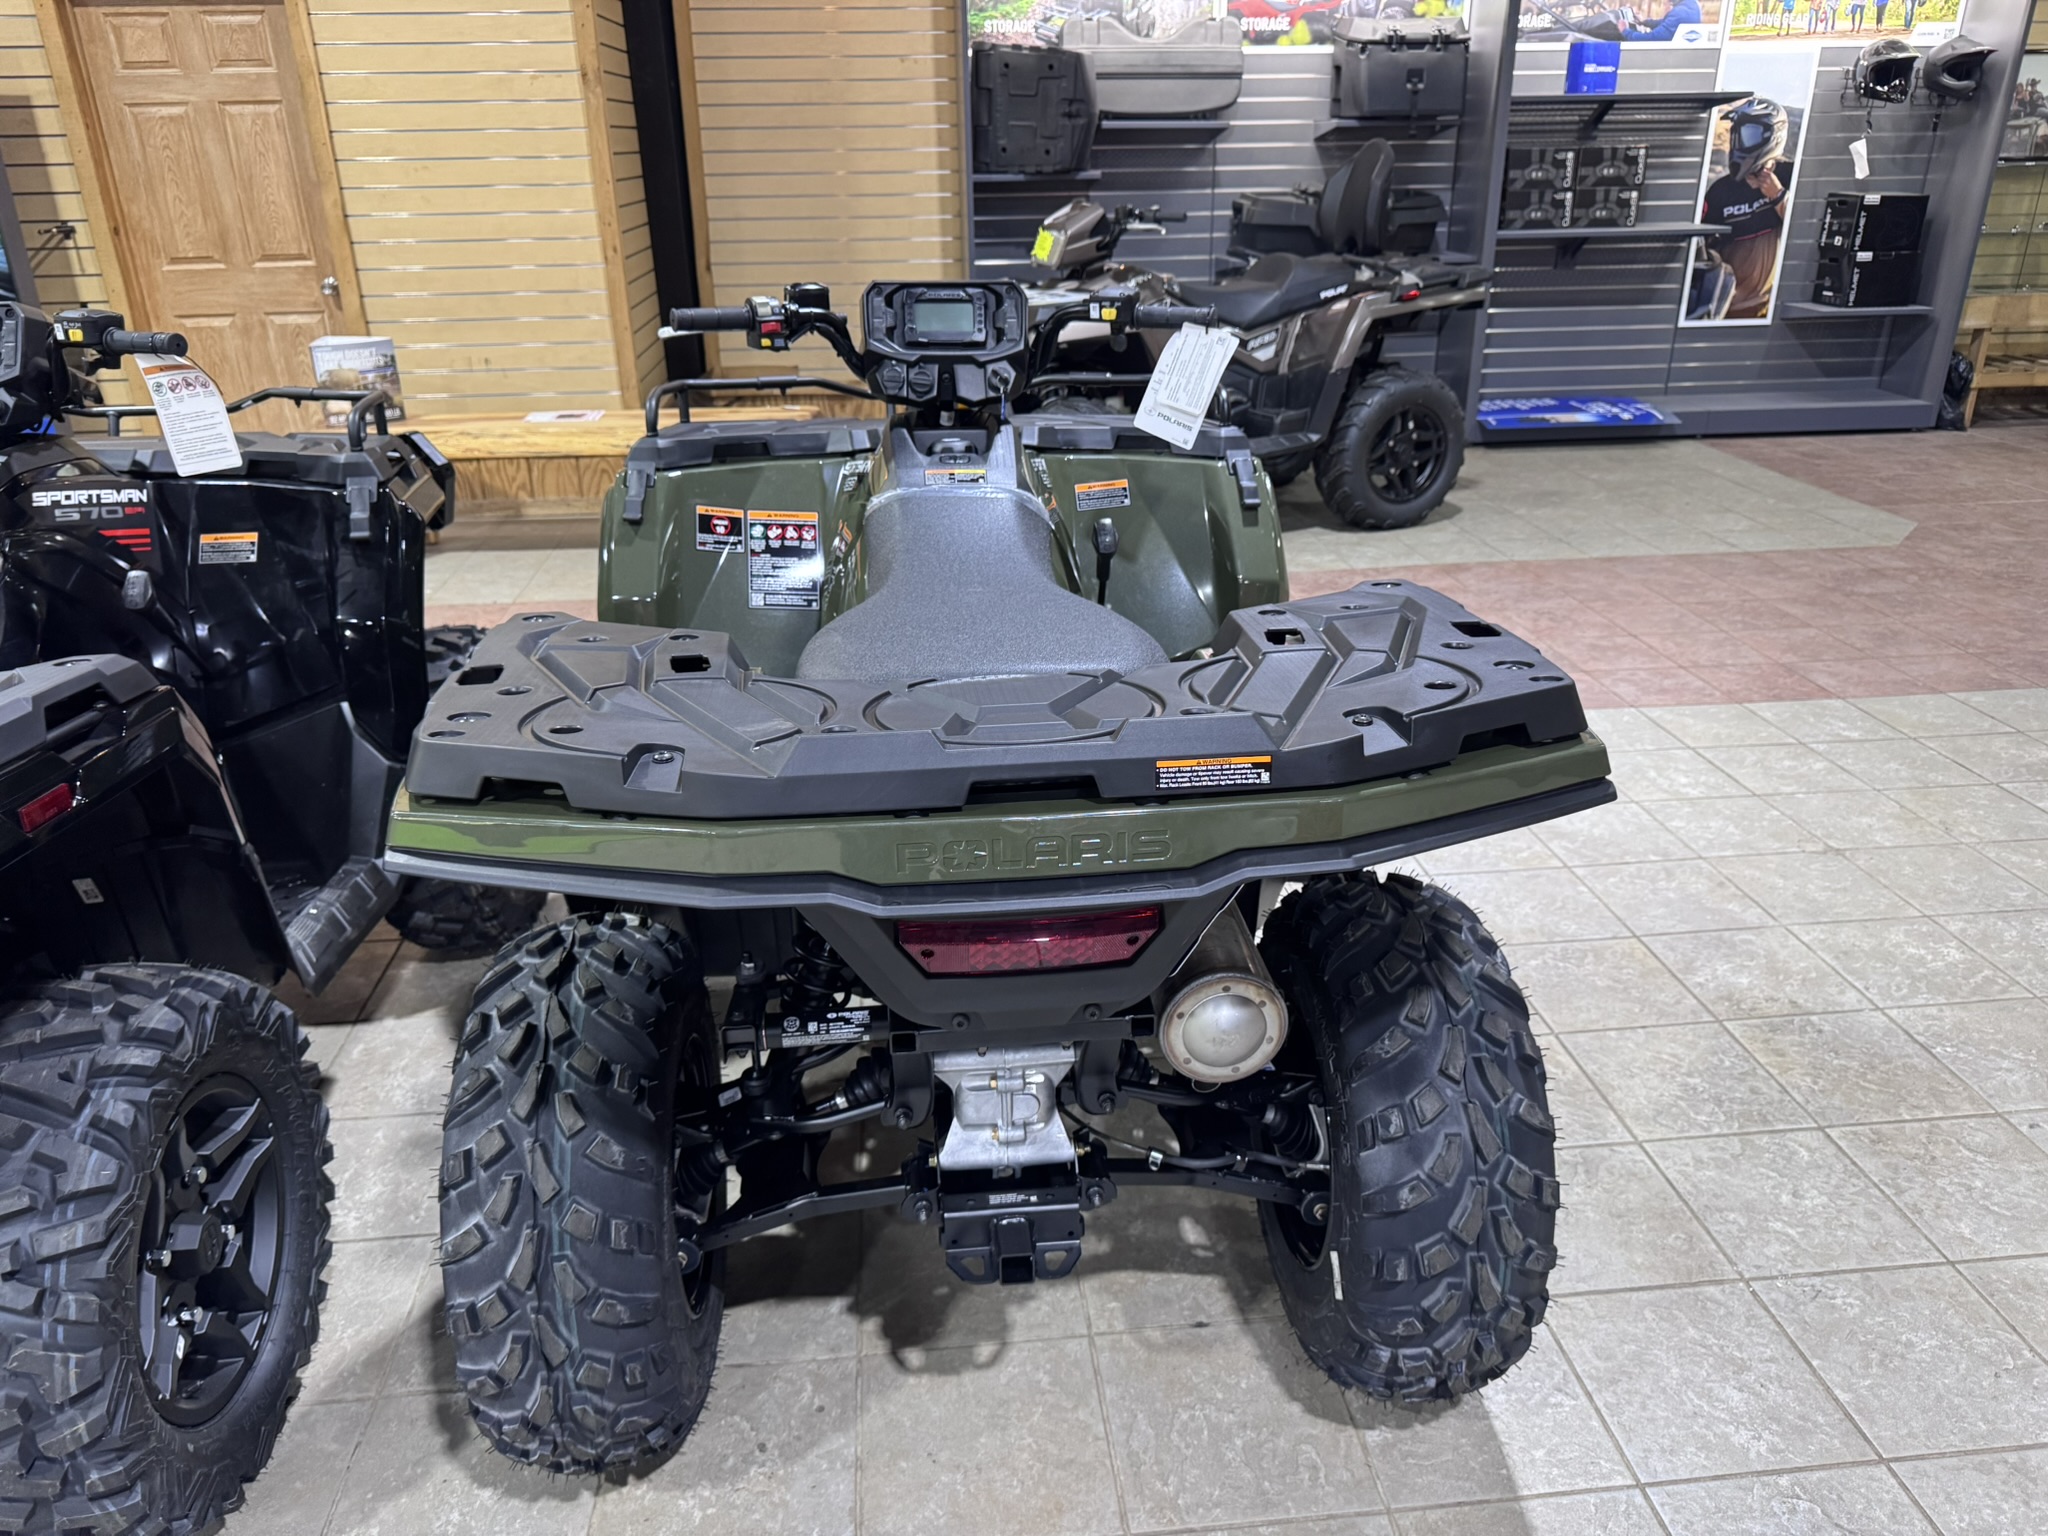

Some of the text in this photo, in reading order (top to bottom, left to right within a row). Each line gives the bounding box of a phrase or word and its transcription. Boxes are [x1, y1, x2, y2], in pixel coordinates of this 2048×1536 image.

[984, 19, 1036, 33] STORAGE
[1240, 17, 1291, 31] STORAGE
[1746, 13, 1809, 26] RIDING GEAR
[1820, 207, 1832, 247] HELMET
[1853, 210, 1867, 250] HELMET
[1848, 266, 1860, 306] HELMET
[1157, 411, 1193, 432] POLARIS
[32, 489, 148, 507] SPORTSMAN
[54, 506, 124, 521] 570
[895, 829, 1173, 876] POLARIS
